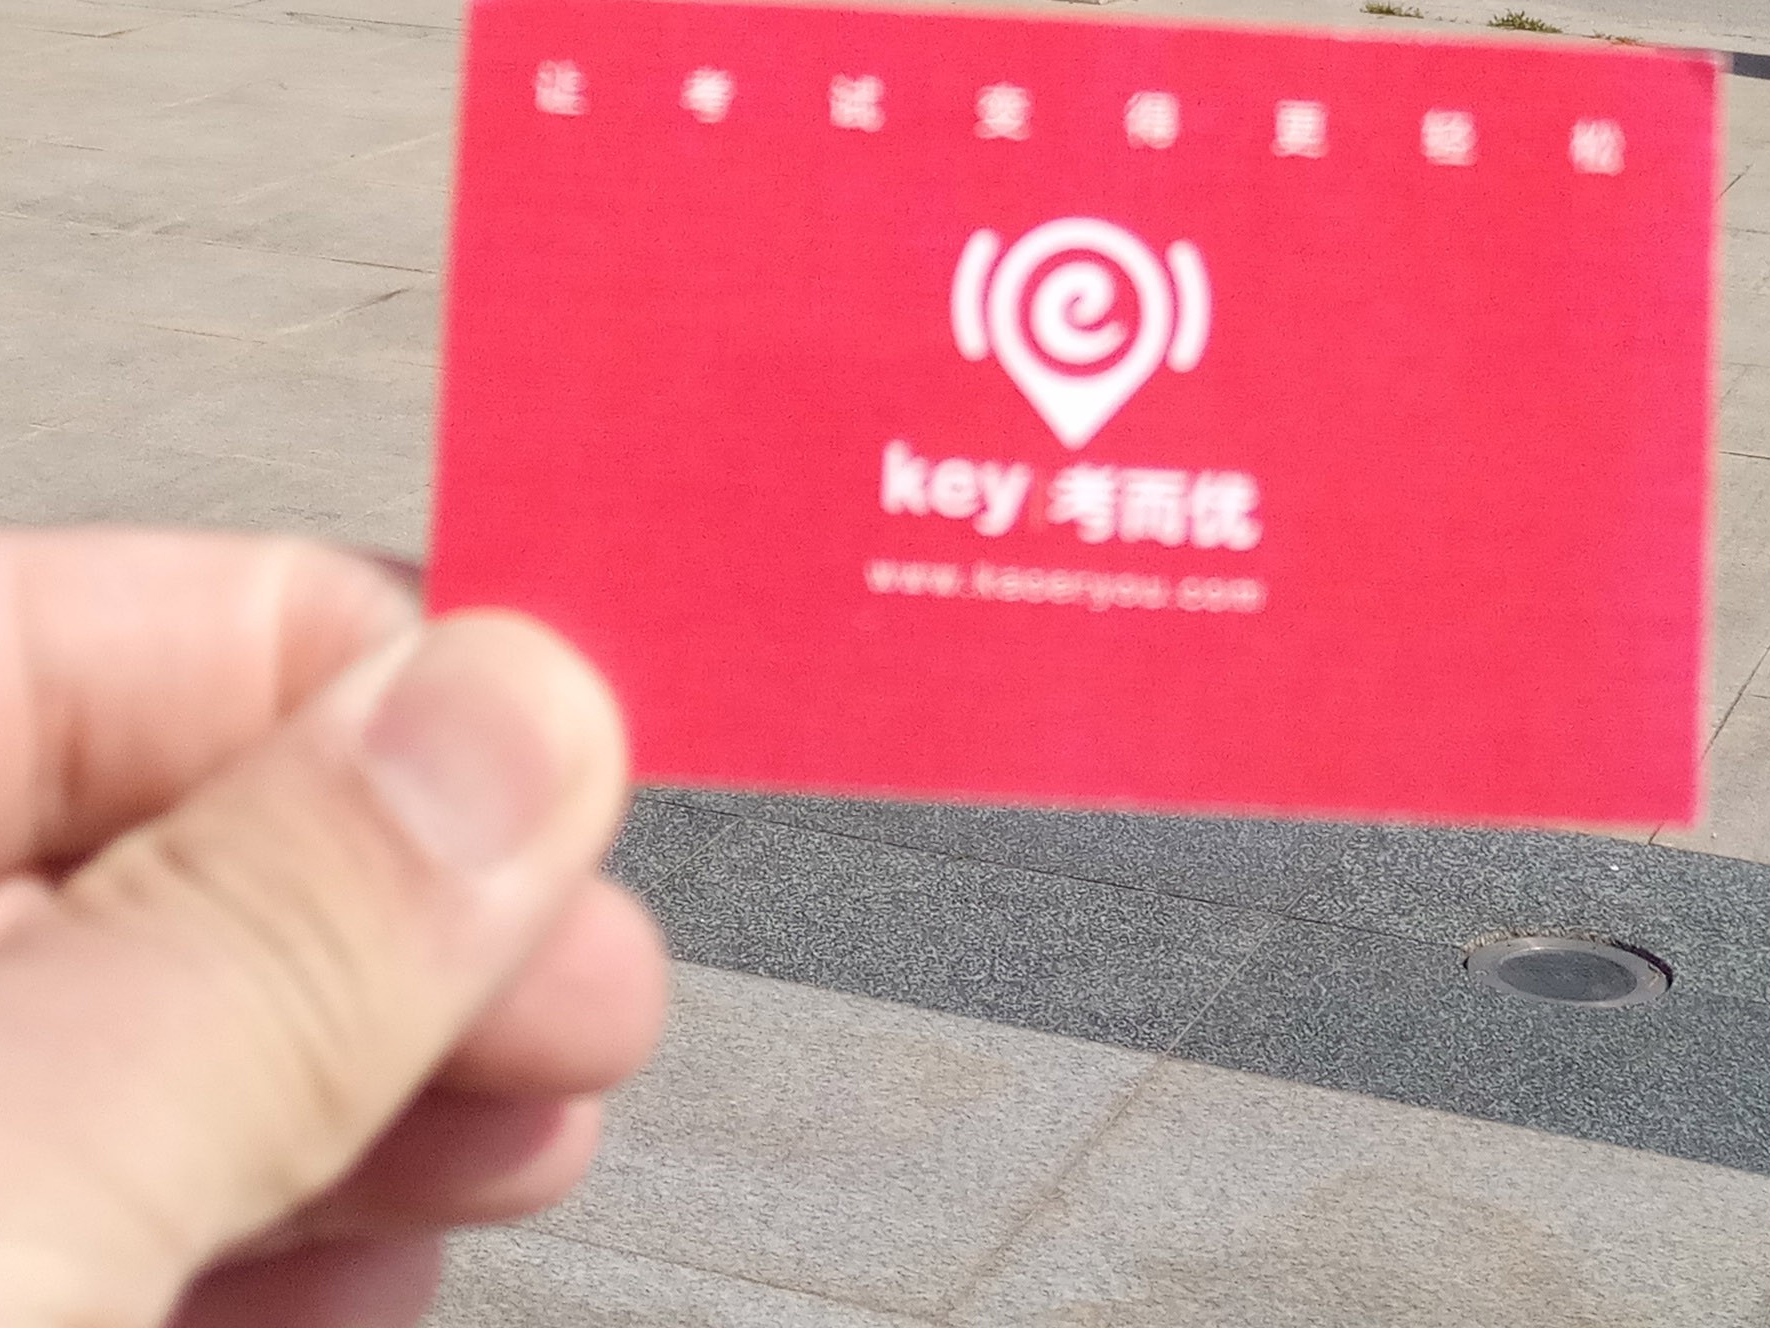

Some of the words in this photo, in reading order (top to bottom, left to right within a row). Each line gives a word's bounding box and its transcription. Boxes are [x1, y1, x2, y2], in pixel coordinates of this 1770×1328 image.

[879, 439, 1032, 537] key
[1046, 459, 1263, 551] 考而优
